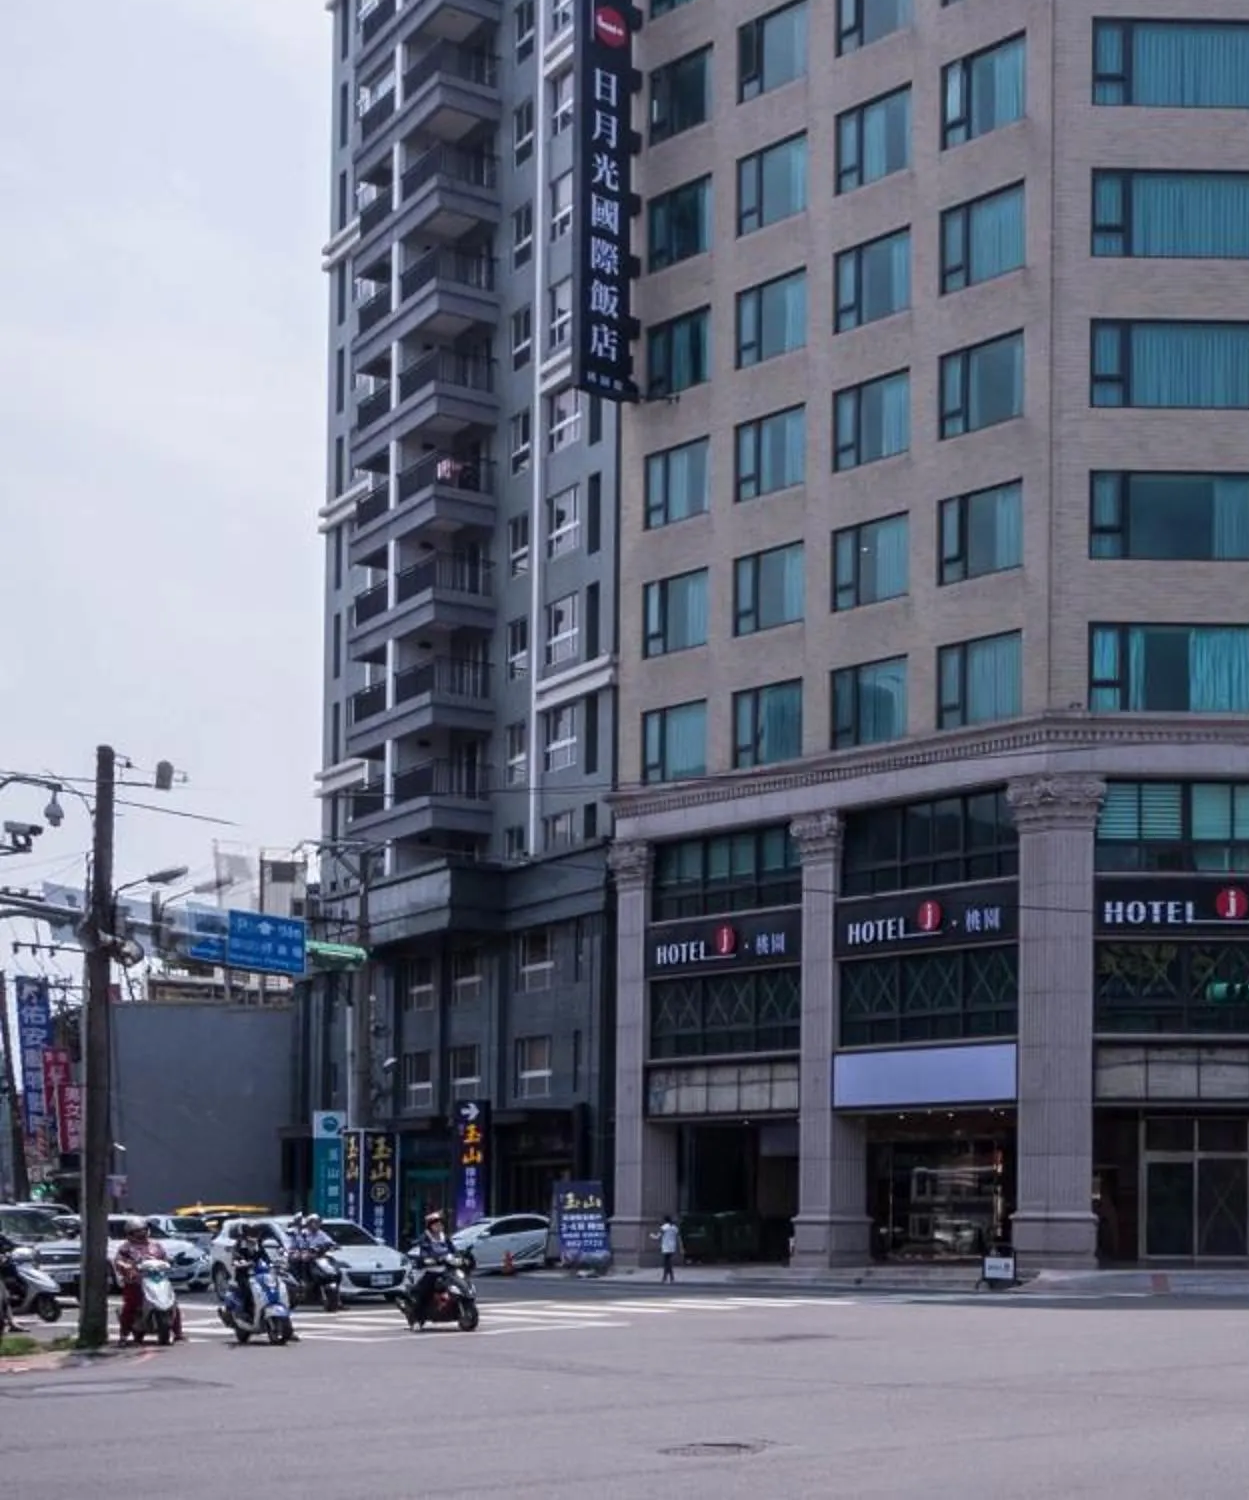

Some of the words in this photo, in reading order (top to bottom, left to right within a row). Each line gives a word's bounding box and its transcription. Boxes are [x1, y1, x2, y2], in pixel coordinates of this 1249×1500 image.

[591, 68, 620, 363] 日月光國際飯店
[1104, 900, 1194, 924] HOTEL
[847, 916, 905, 945] HOTEL
[656, 941, 705, 965] HOTEL
[462, 1124, 482, 1165] 玉山
